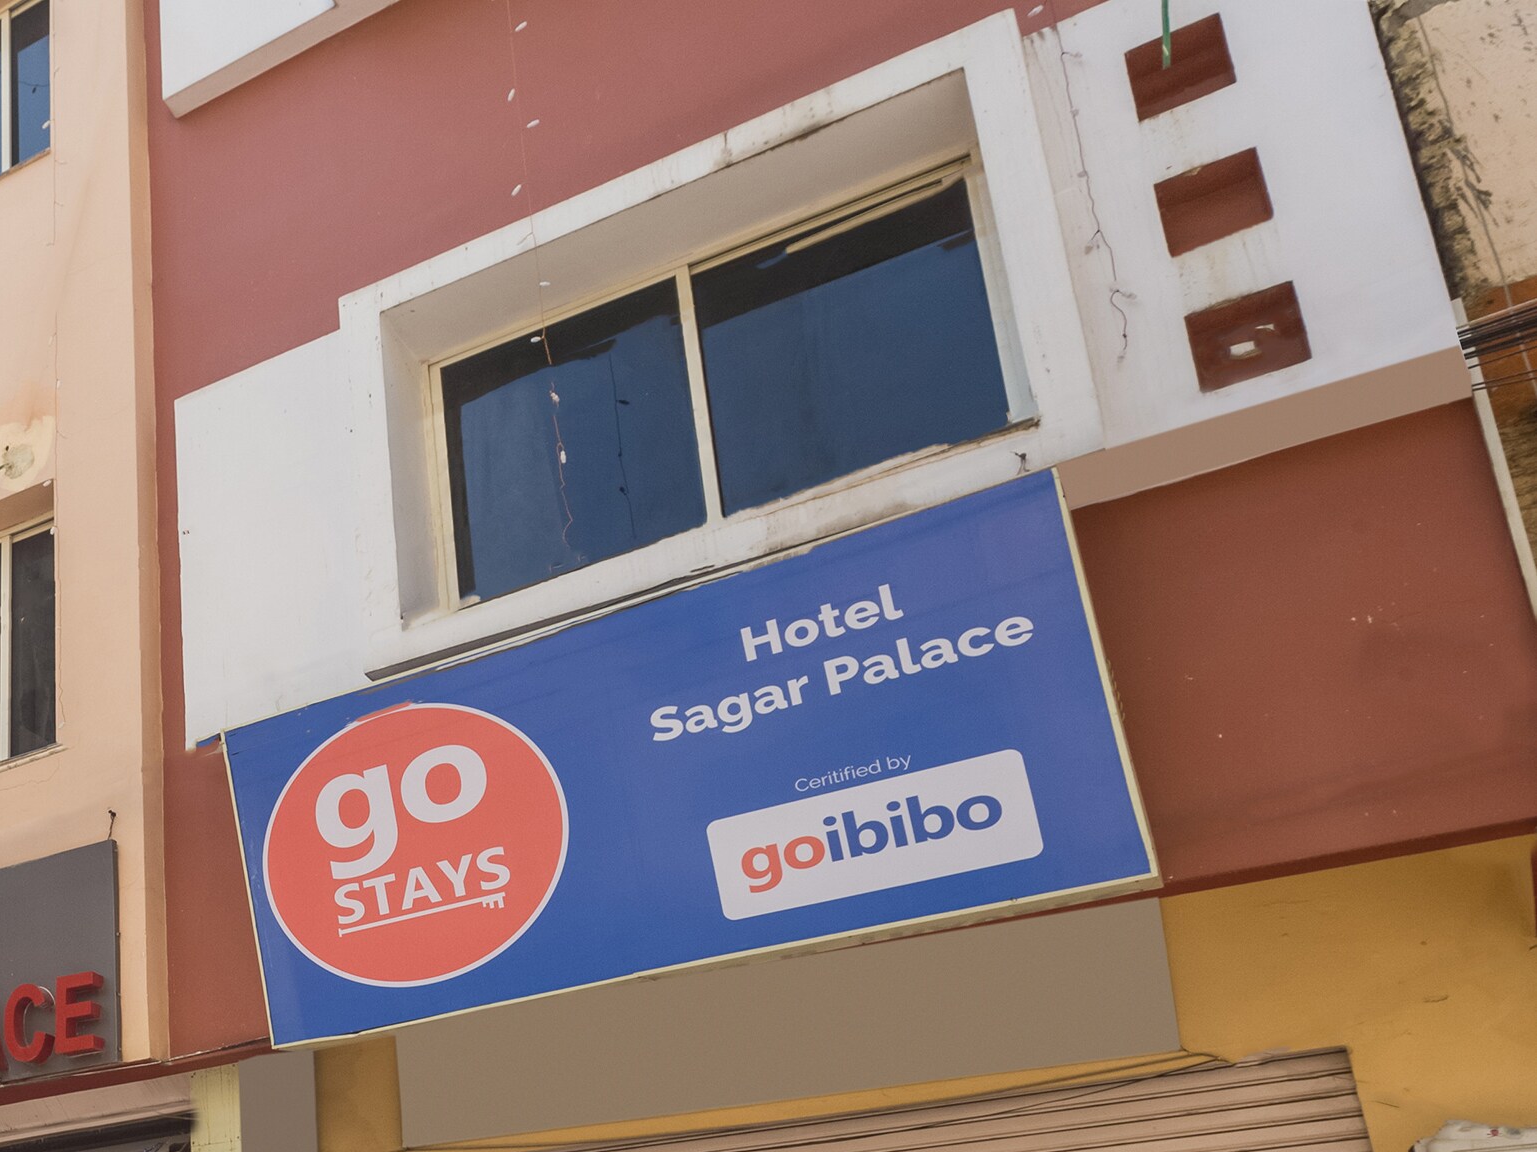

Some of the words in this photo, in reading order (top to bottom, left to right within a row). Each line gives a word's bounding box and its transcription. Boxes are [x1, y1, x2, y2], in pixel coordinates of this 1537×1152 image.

[740, 583, 904, 662] Hotel
[649, 675, 810, 742] Sagar
[823, 615, 1035, 696] Palace
[315, 744, 488, 880] go
[794, 759, 883, 792] Ceritified
[885, 754, 912, 771] by
[333, 846, 511, 925] STAYS
[740, 795, 1004, 894] goibibo
